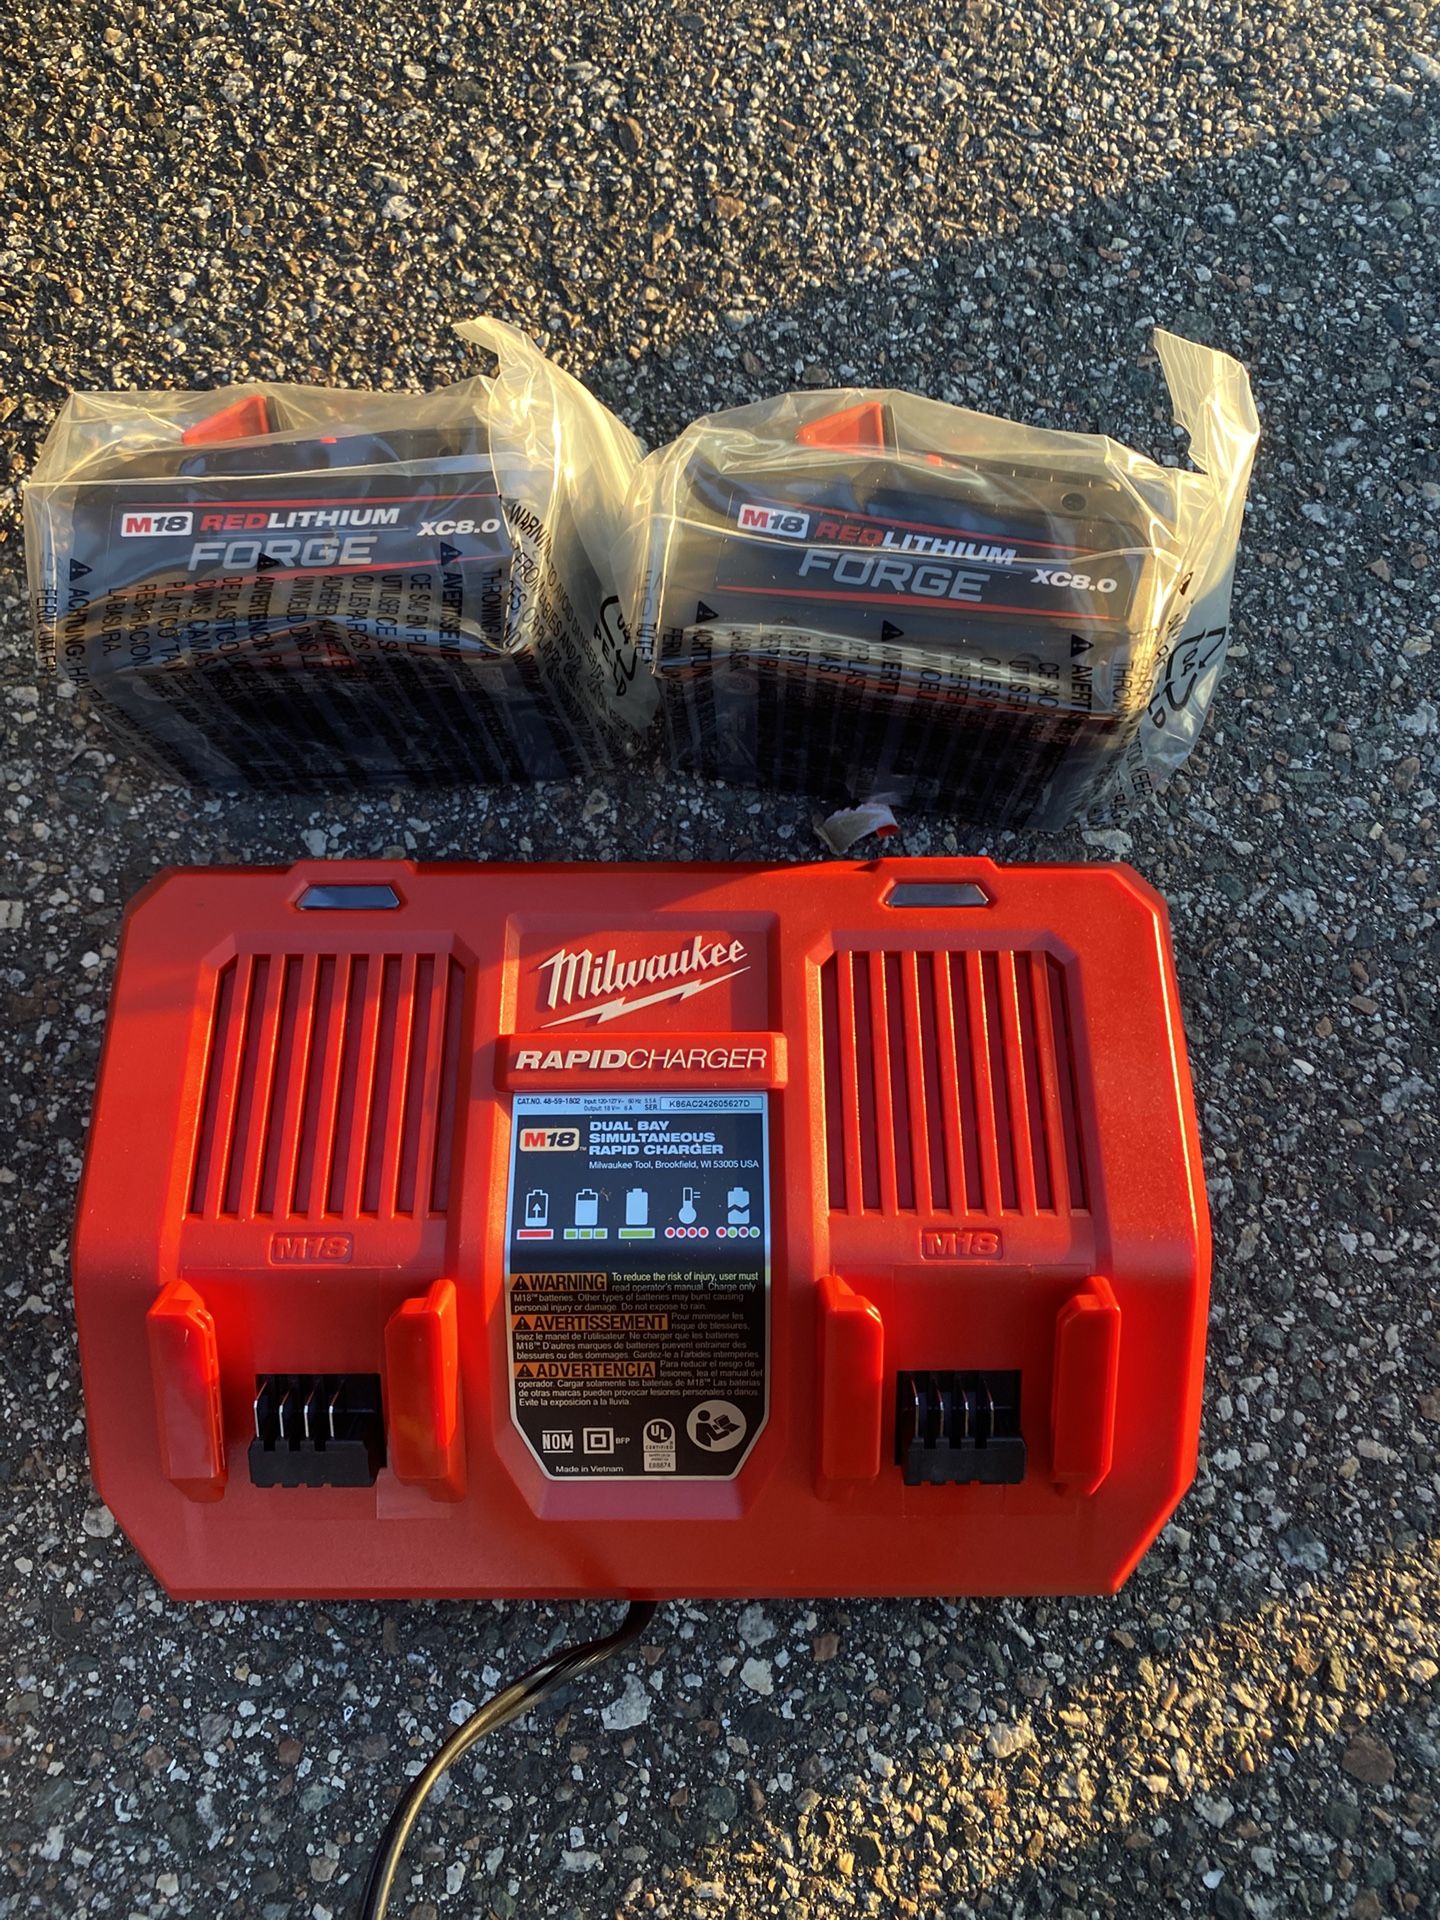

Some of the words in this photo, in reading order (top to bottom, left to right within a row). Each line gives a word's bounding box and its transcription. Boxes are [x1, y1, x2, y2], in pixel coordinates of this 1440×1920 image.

[126, 514, 188, 533] M18
[200, 508, 400, 531] REDLITHIUM
[417, 518, 501, 537] XC8.0
[741, 509, 805, 533] M18
[814, 521, 1017, 566] REDLITHIUM
[187, 536, 378, 571] FORGE
[799, 548, 989, 602] FORGE
[1030, 567, 1117, 593] XC8.0
[538, 935, 749, 1010] Milwaukee
[590, 1122, 633, 1131] DUAL
[637, 1120, 670, 1131] BAY
[589, 1132, 716, 1143] SIMULTANEOUS
[588, 1145, 640, 1155] RAPID
[643, 1144, 724, 1155] CHARGER
[589, 1160, 633, 1169] Milwaukee
[634, 1160, 654, 1170] Tool,
[655, 1160, 699, 1170] Brookfield,
[700, 1160, 712, 1168] WI
[713, 1160, 739, 1168] 53005
[740, 1160, 760, 1168] USA
[925, 1232, 999, 1256] M18
[530, 1274, 605, 1291] WARNING
[612, 1272, 622, 1281] To
[624, 1272, 652, 1281] reduce
[653, 1272, 665, 1281] the
[668, 1272, 683, 1281] risk
[684, 1272, 693, 1281] of
[694, 1272, 718, 1283] injury,
[738, 1273, 759, 1281] must
[534, 1315, 666, 1330] AVERTISSEMENT
[536, 1362, 654, 1378] ADVERTENCIA
[542, 1434, 574, 1450] NOM
[556, 1465, 580, 1473] Made
[581, 1465, 589, 1473] in
[590, 1465, 624, 1473] Vietnam
